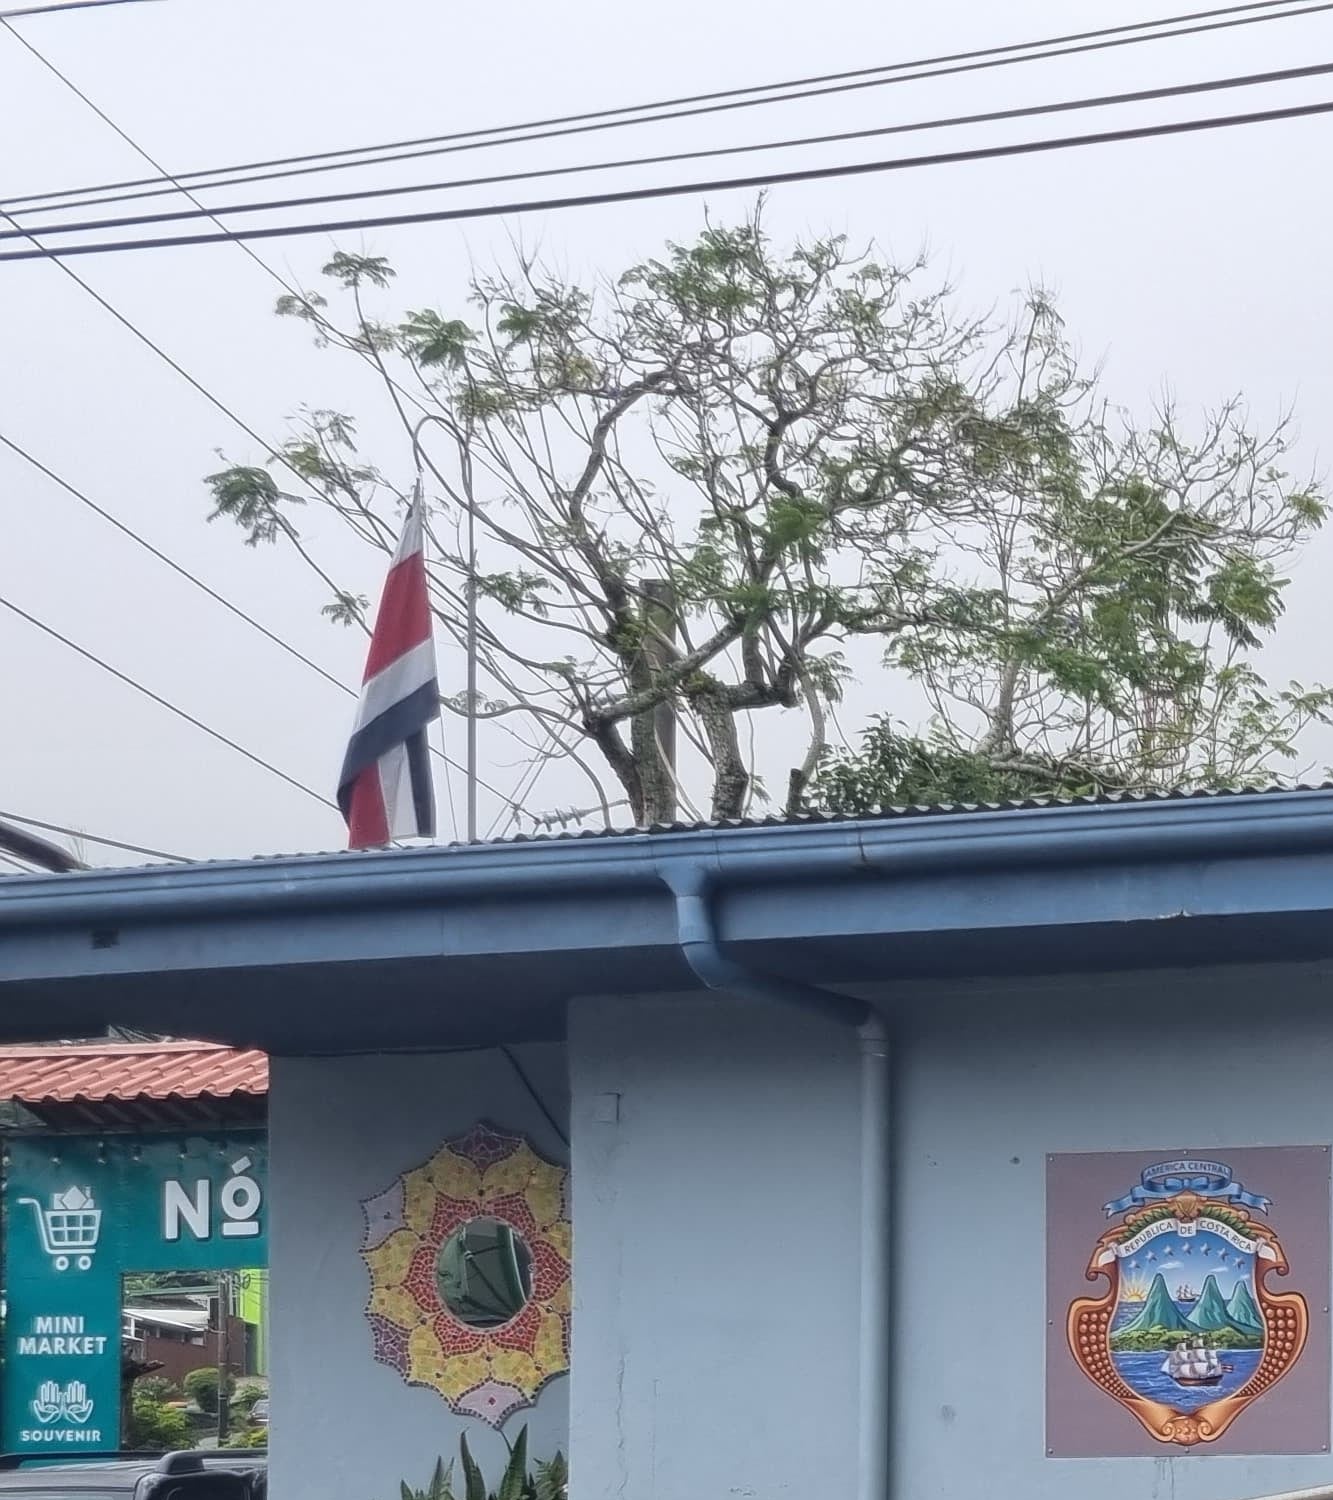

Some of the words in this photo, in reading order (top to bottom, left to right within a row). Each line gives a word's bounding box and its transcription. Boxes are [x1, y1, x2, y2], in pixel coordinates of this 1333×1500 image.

[1180, 1225, 1193, 1235] DE
[1200, 1220, 1230, 1238] COSTA
[1231, 1235, 1252, 1251] RICA
[36, 1315, 85, 1335] MINI
[19, 1335, 108, 1356] MARKET
[20, 1429, 102, 1443] SOUVENIR
